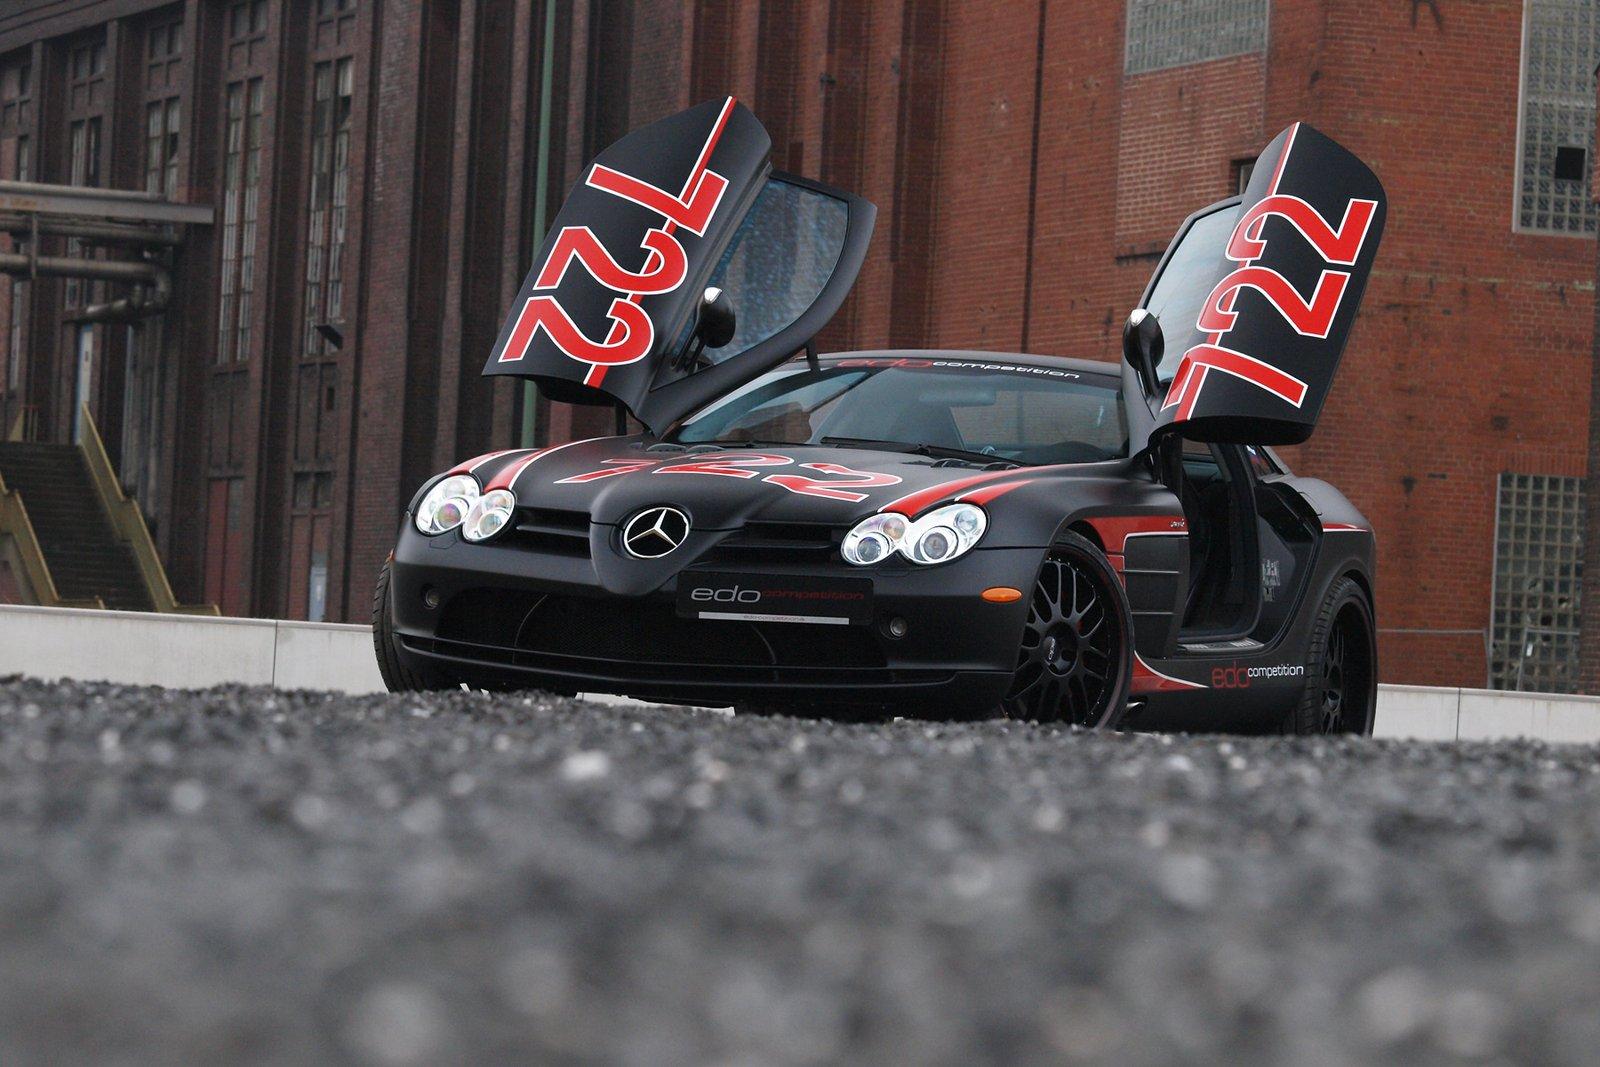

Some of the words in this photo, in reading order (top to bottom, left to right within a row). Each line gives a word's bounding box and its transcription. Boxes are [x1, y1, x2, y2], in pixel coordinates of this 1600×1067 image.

[498, 163, 730, 366] 722
[1160, 194, 1379, 411] 722
[932, 361, 1080, 379] competition
[553, 453, 903, 503] 722
[690, 585, 761, 603] edo
[1211, 660, 1250, 688] edo
[1247, 663, 1304, 678] competition
